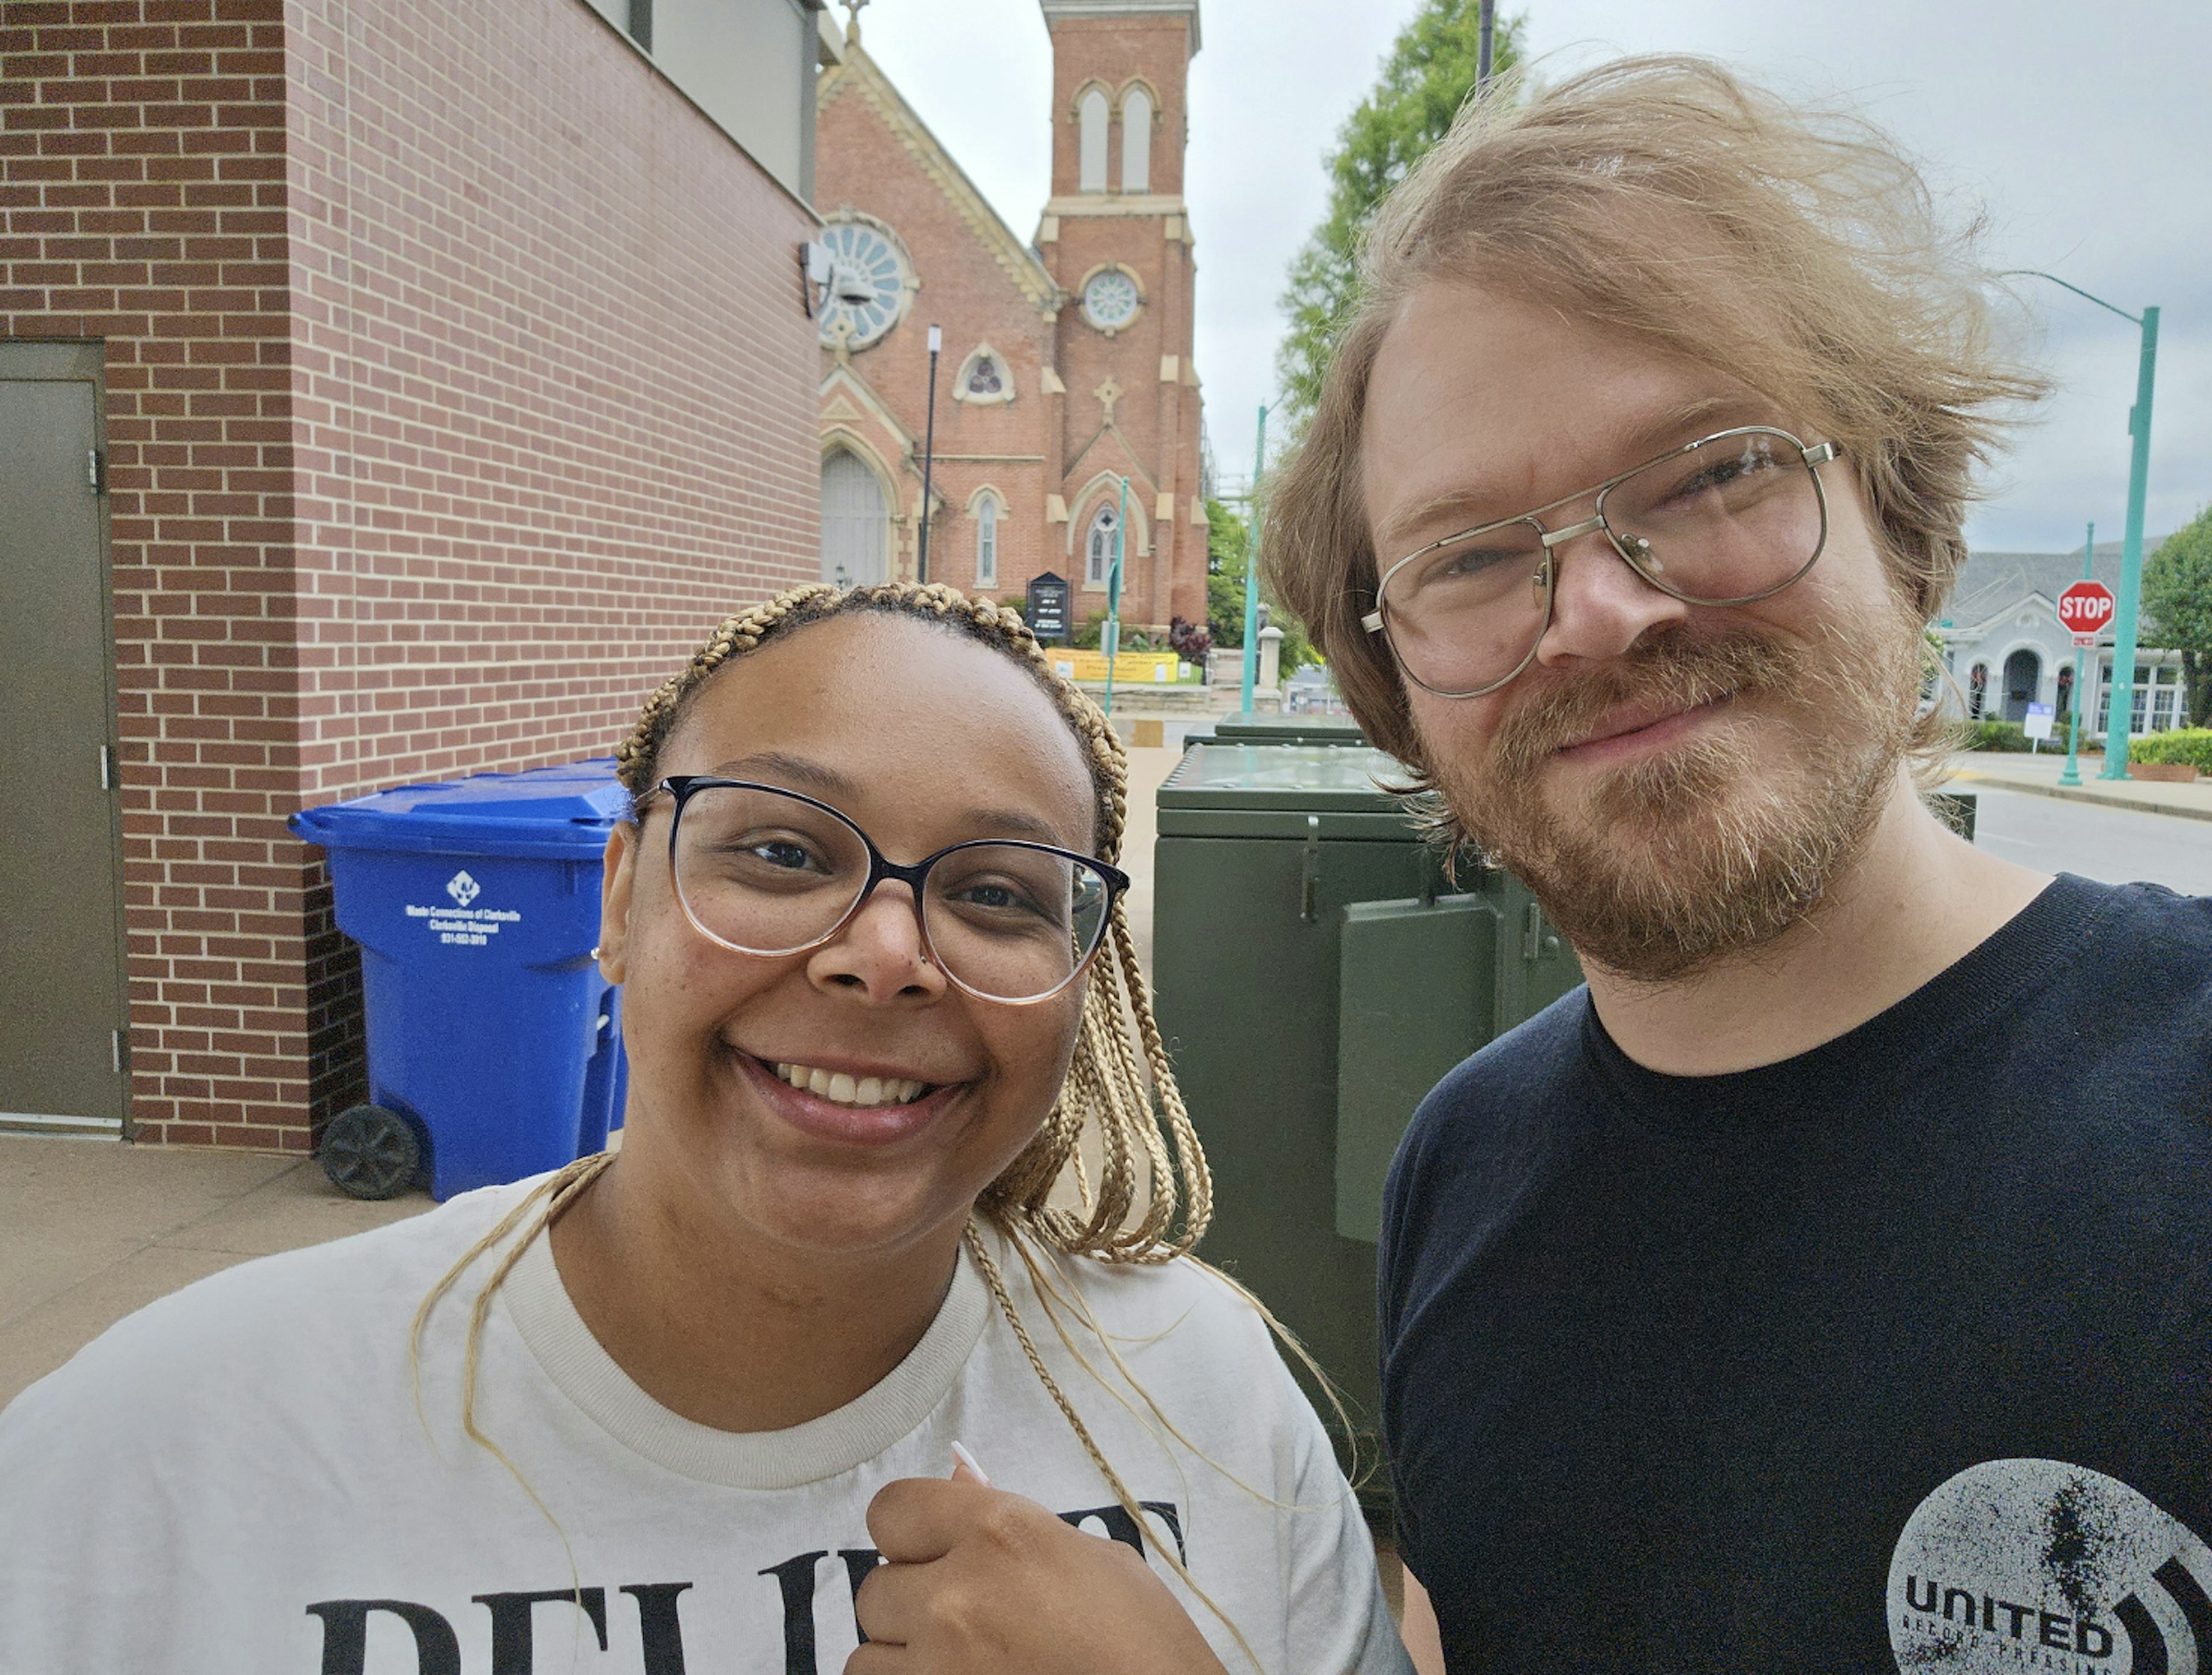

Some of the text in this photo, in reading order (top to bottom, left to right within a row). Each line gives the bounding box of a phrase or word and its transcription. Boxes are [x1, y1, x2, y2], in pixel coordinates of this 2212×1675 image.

[2061, 596, 2112, 619] STOP
[475, 909, 483, 919] of
[1906, 1574, 2113, 1658] UNITED
